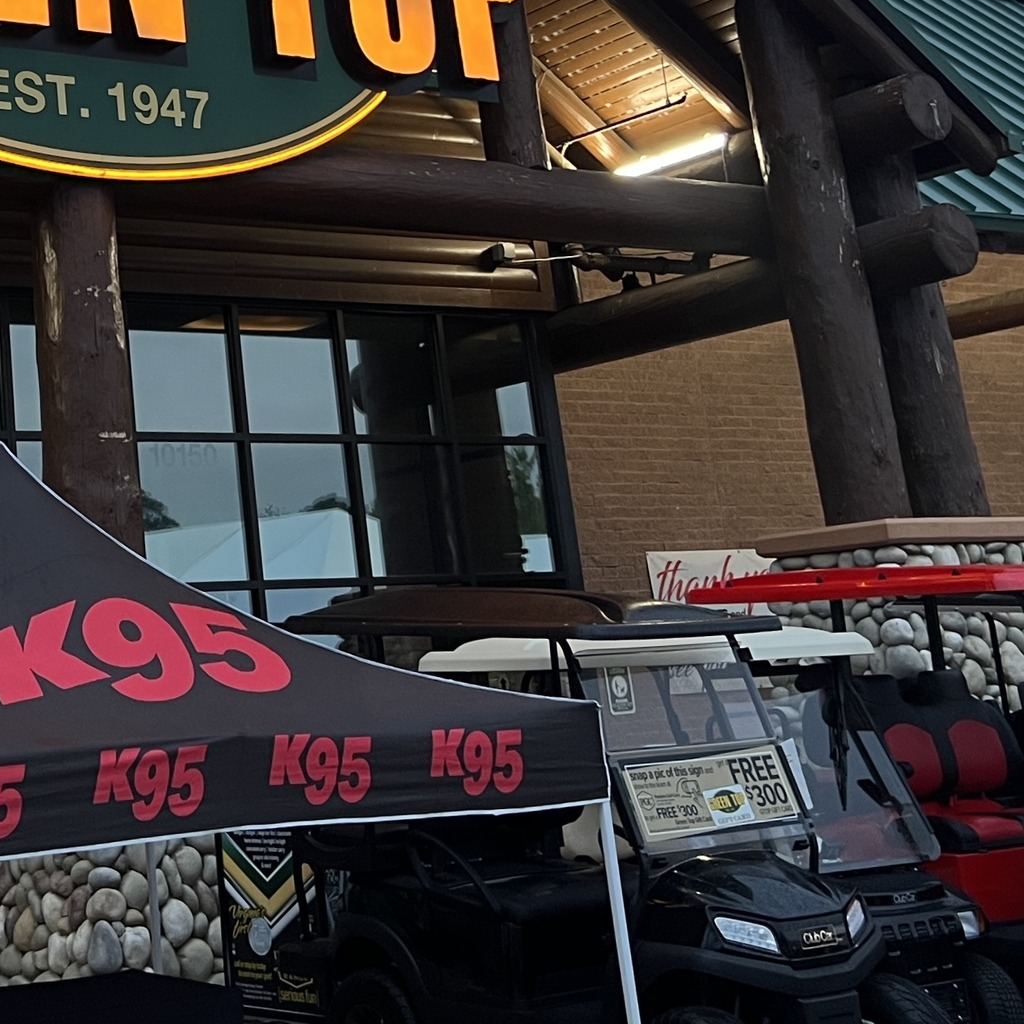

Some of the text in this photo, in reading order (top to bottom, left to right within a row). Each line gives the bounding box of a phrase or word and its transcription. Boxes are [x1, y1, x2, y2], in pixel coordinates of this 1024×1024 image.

[107, 82, 209, 129] 1947
[149, 443, 218, 467] 10150
[268, 734, 373, 805] K95
[430, 729, 524, 795] K95
[630, 772, 648, 782] snap
[648, 771, 653, 780] a
[654, 768, 666, 781] pic
[666, 766, 674, 778] of
[674, 765, 688, 777] this
[688, 764, 704, 778] sign
[727, 754, 780, 784] FREE
[93, 744, 208, 822] K95
[745, 782, 788, 807] $300
[657, 806, 678, 819] FREE
[677, 804, 699, 817] $300
